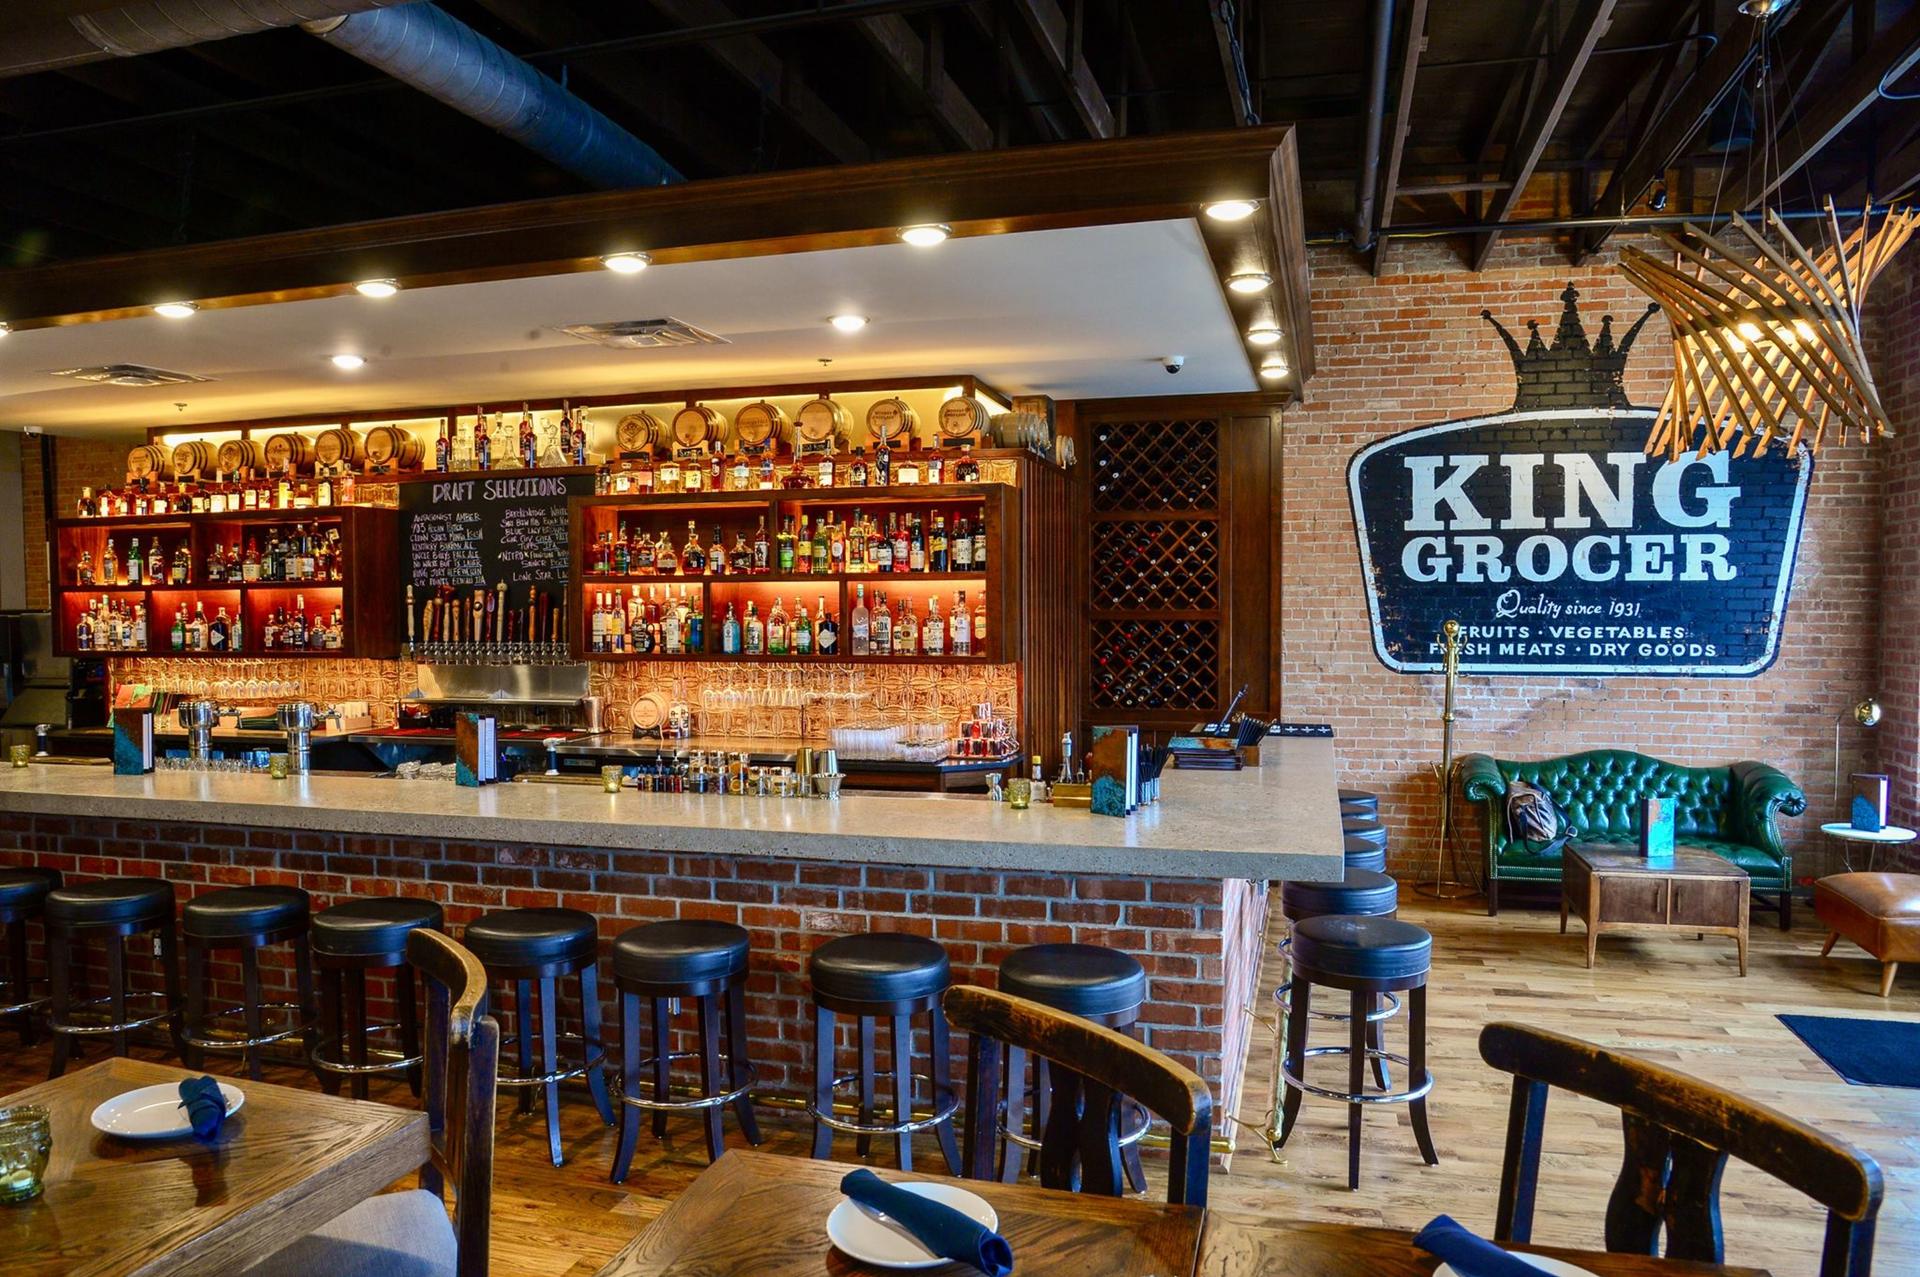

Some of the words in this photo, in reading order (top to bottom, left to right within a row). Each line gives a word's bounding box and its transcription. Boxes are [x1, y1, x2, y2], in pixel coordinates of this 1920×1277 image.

[432, 481, 475, 503] DRAFT
[483, 477, 567, 500] SELECTIONS
[1403, 449, 1741, 531] KING
[502, 550, 524, 561] NITRO
[1401, 533, 1738, 582] GROCER
[1496, 589, 1562, 618] Quality
[1565, 600, 1602, 615] since
[1608, 600, 1641, 618] 1931
[1459, 625, 1530, 639] FRUITS
[1548, 626, 1685, 639] VEGETABLES
[1499, 642, 1566, 656] MEATS
[1589, 643, 1631, 656] DRY
[1638, 643, 1717, 657] GOODS
